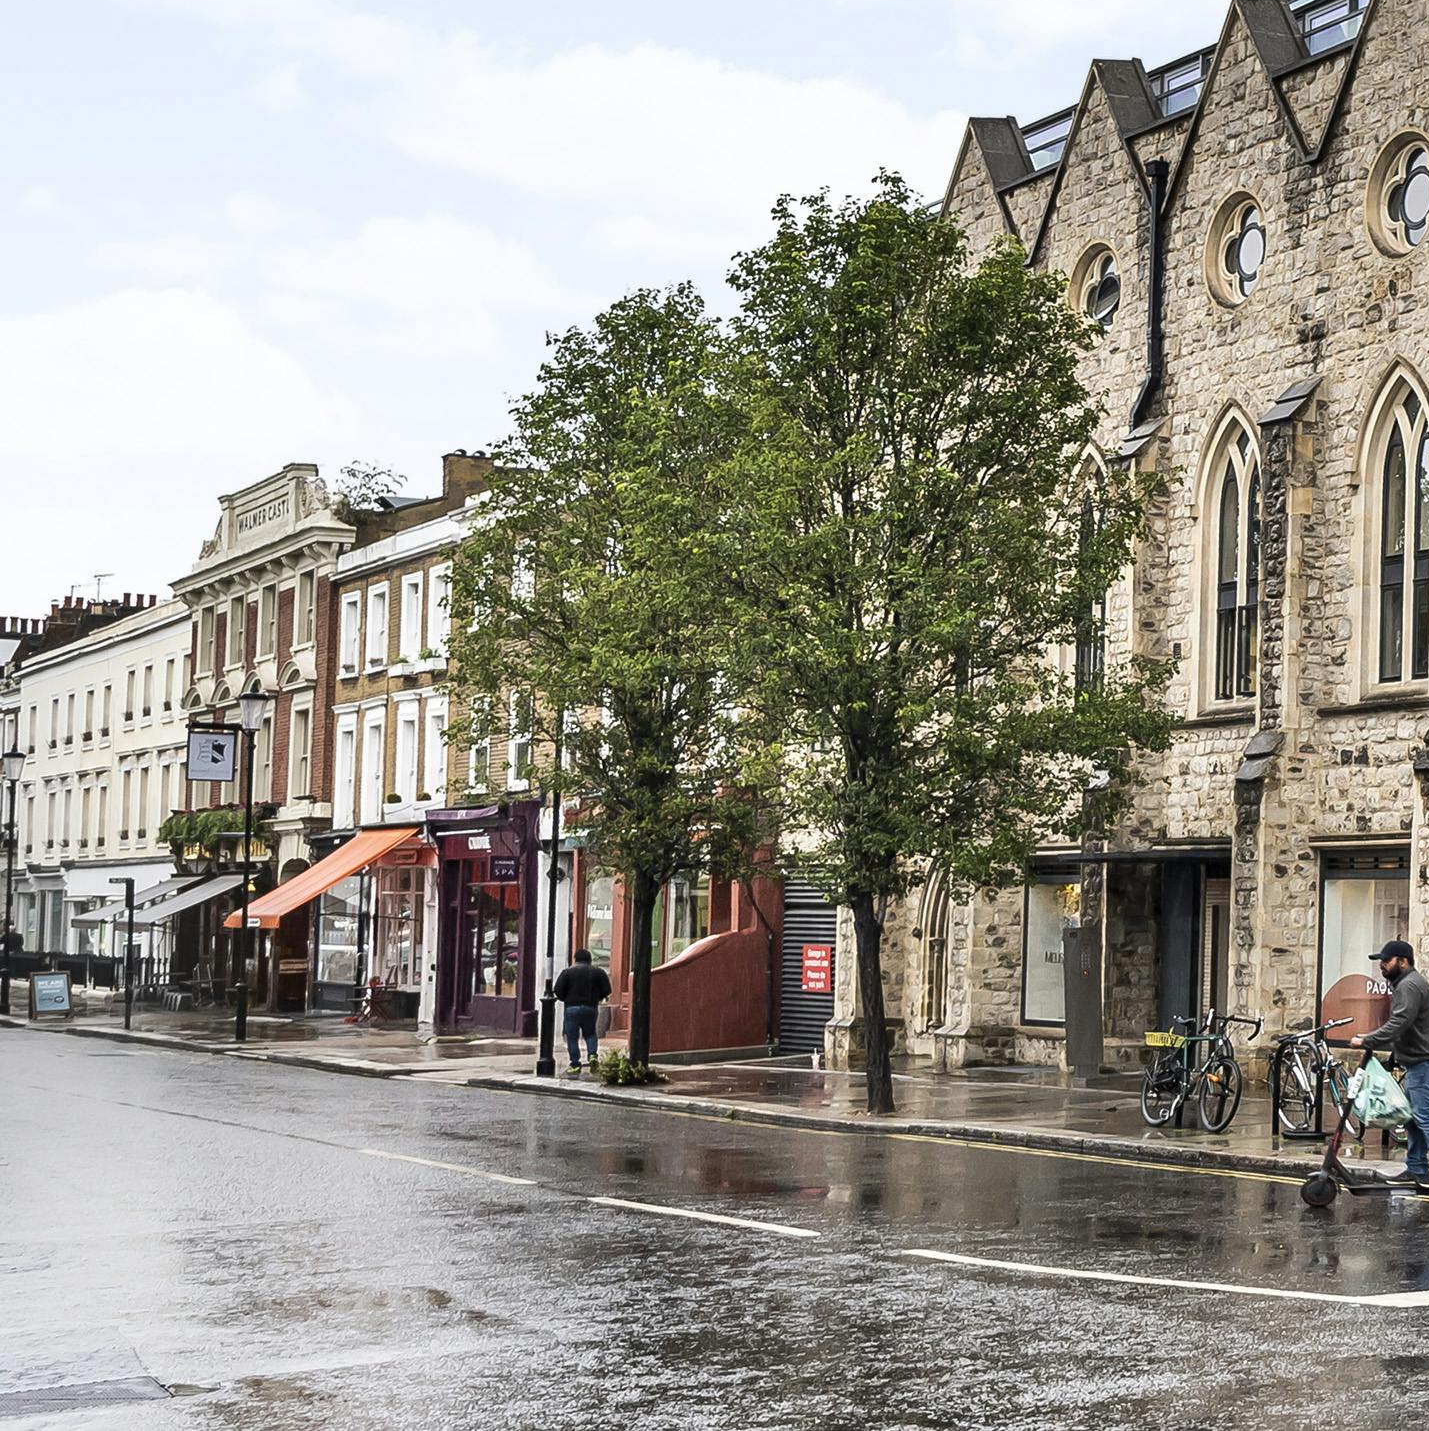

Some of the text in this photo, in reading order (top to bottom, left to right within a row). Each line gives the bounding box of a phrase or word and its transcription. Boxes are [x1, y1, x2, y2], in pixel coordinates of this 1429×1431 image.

[239, 498, 289, 534] WALMER CASTL
[1366, 980, 1393, 994] PAOL
